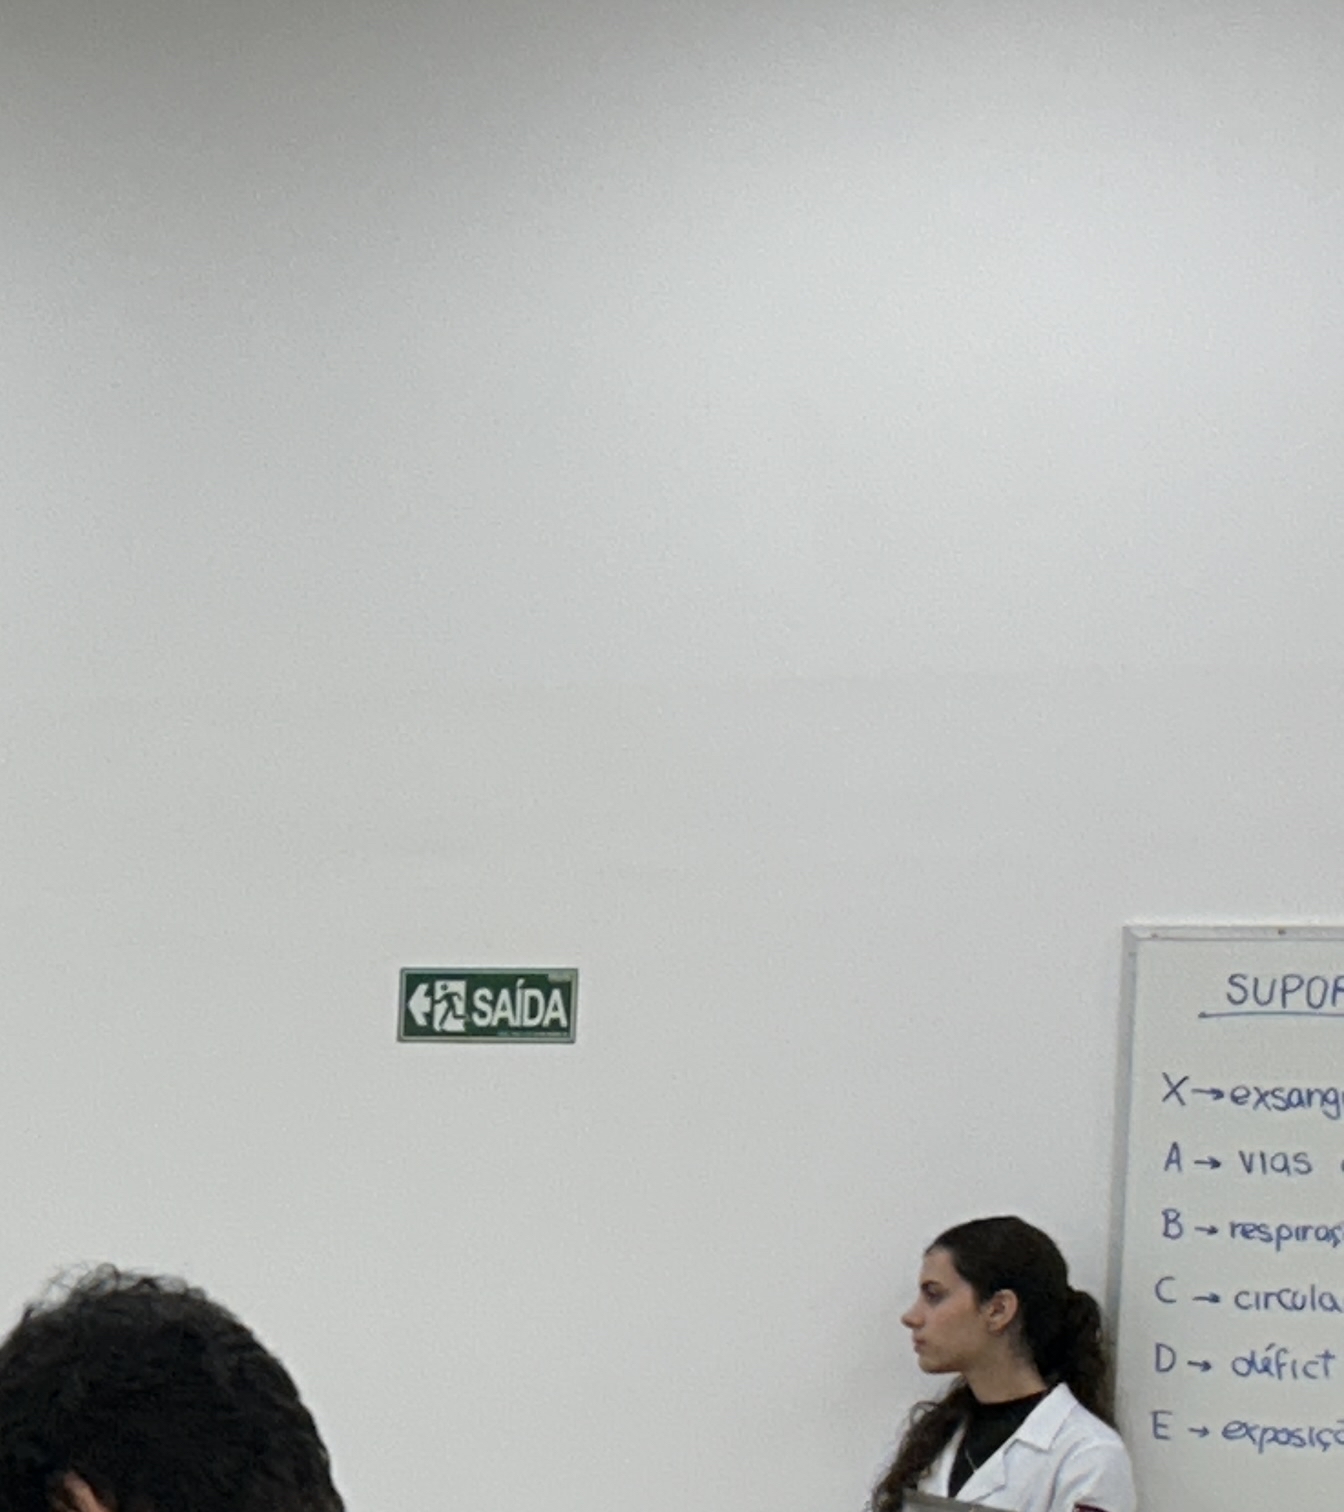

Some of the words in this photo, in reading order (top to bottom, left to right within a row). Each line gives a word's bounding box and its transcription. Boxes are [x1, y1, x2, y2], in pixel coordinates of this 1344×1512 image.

[472, 979, 568, 1027] SAÍDA
[1162, 1072, 1190, 1106] X
[1230, 1084, 1344, 1120] exsang
[1164, 1142, 1183, 1172] A
[1238, 1149, 1313, 1177] vias
[1162, 1208, 1183, 1239] B
[1229, 1219, 1344, 1252] respiraç
[1155, 1276, 1177, 1303] C
[1156, 1343, 1177, 1372] D
[1151, 1411, 1174, 1440] E
